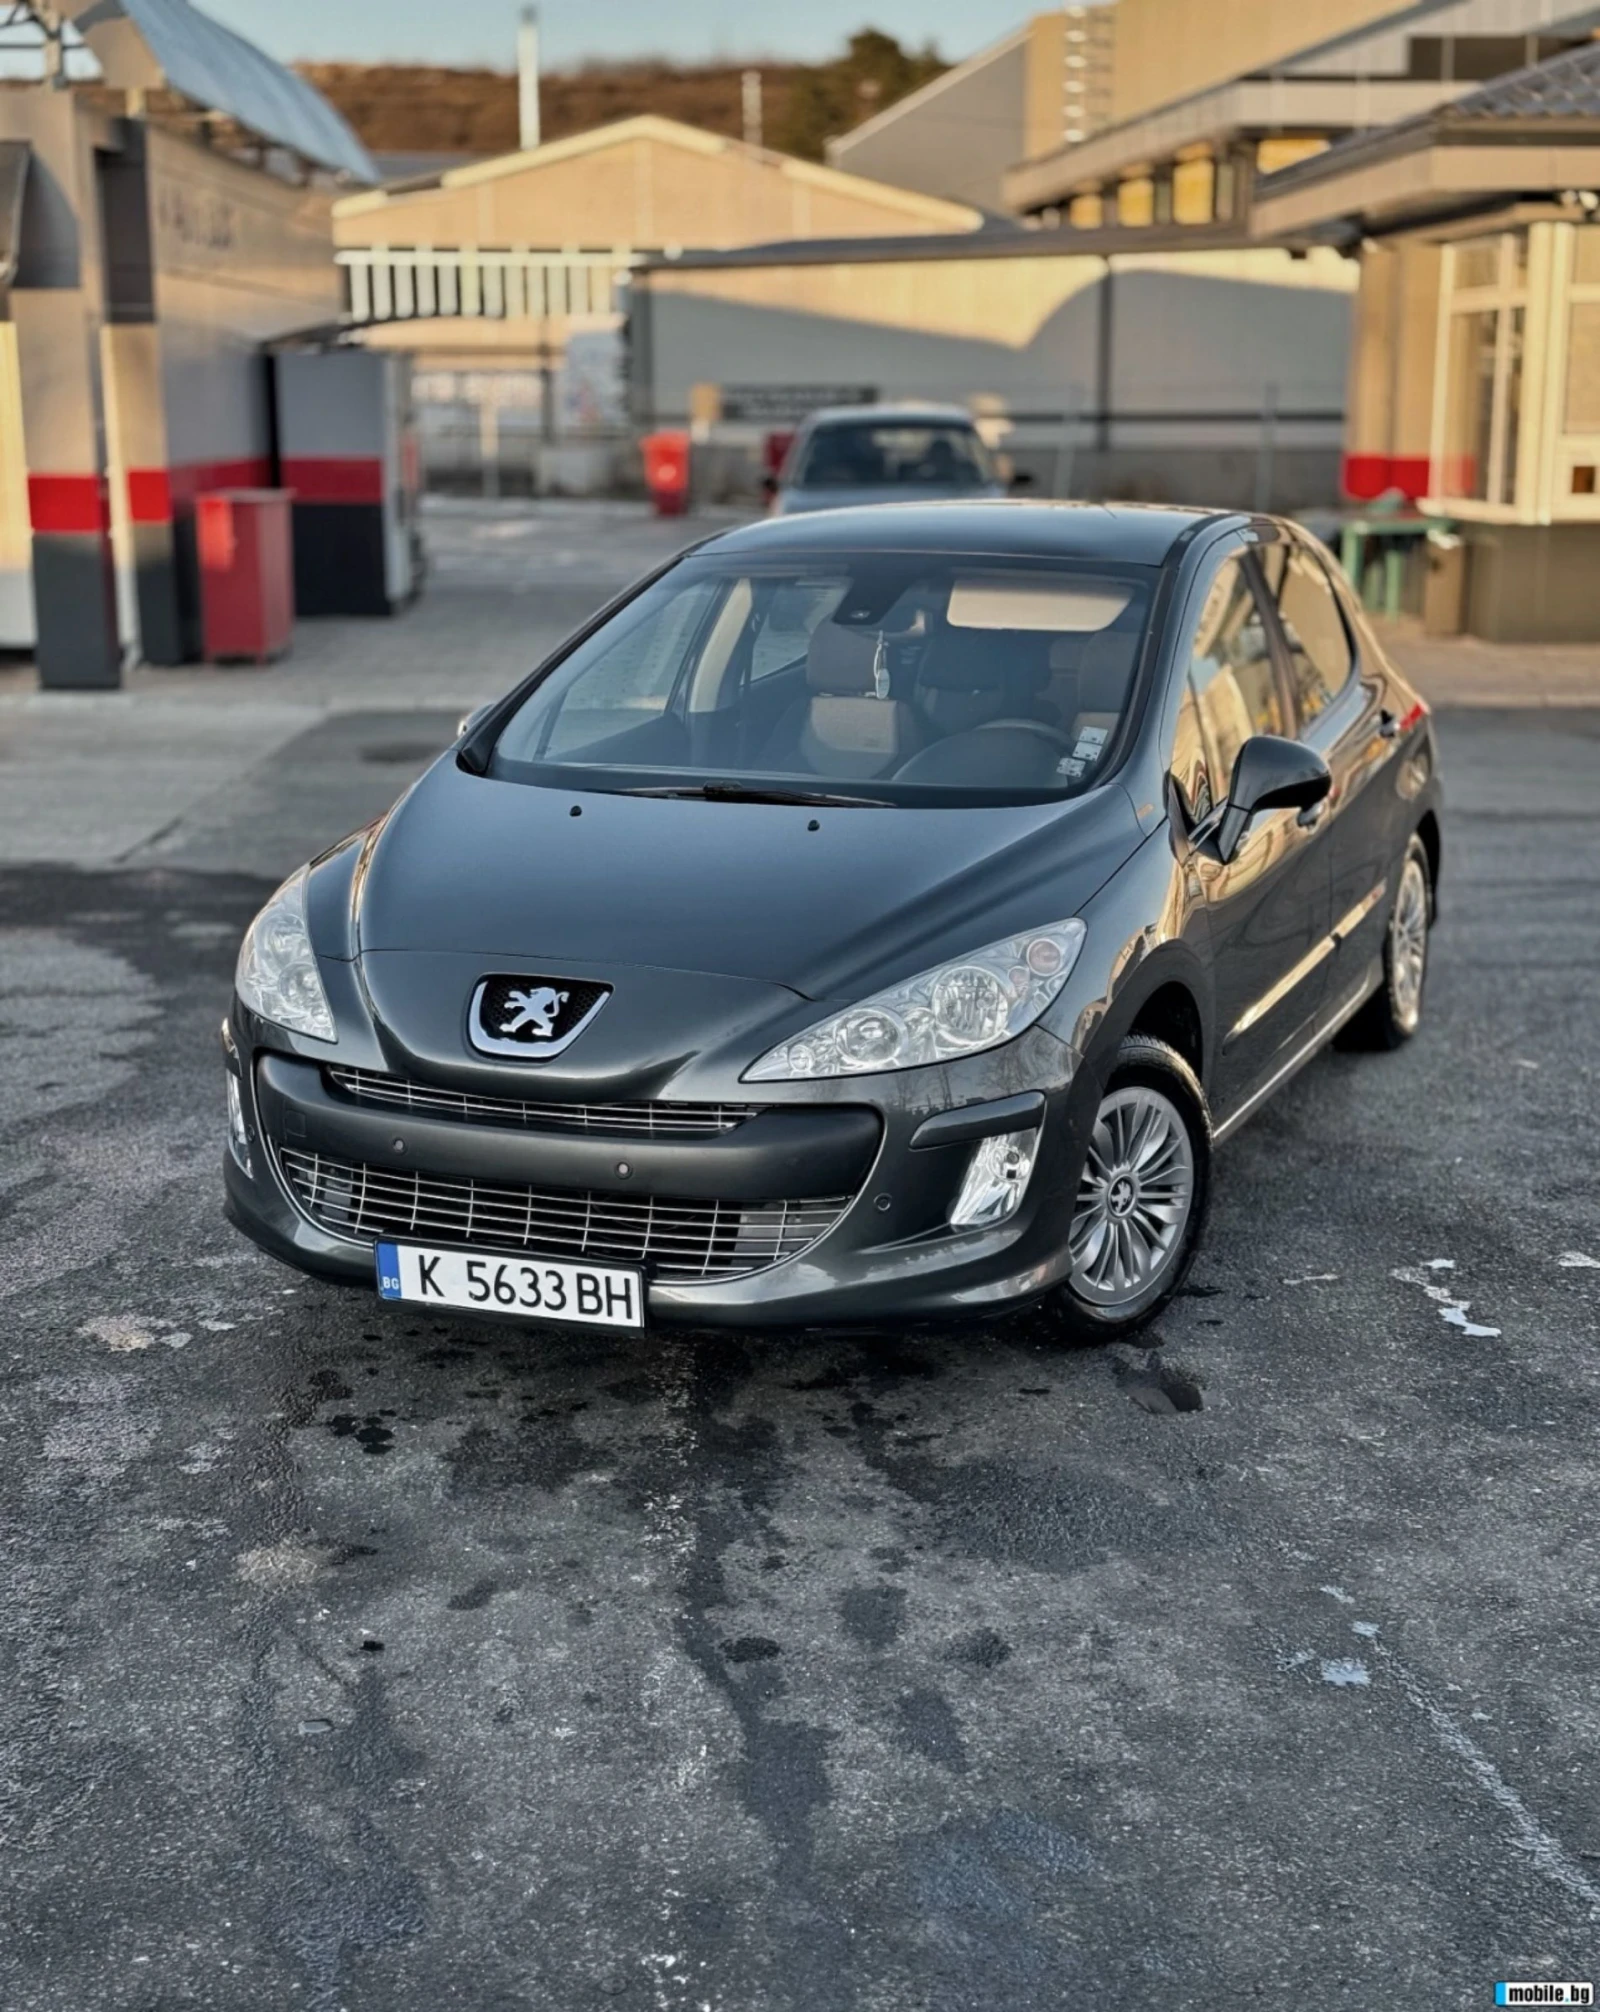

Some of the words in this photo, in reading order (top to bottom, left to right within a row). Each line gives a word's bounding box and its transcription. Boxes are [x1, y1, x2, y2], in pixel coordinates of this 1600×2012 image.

[382, 1275, 399, 1290] BG
[418, 1254, 445, 1297] K
[466, 1260, 567, 1311] 5633
[576, 1272, 633, 1320] BH
